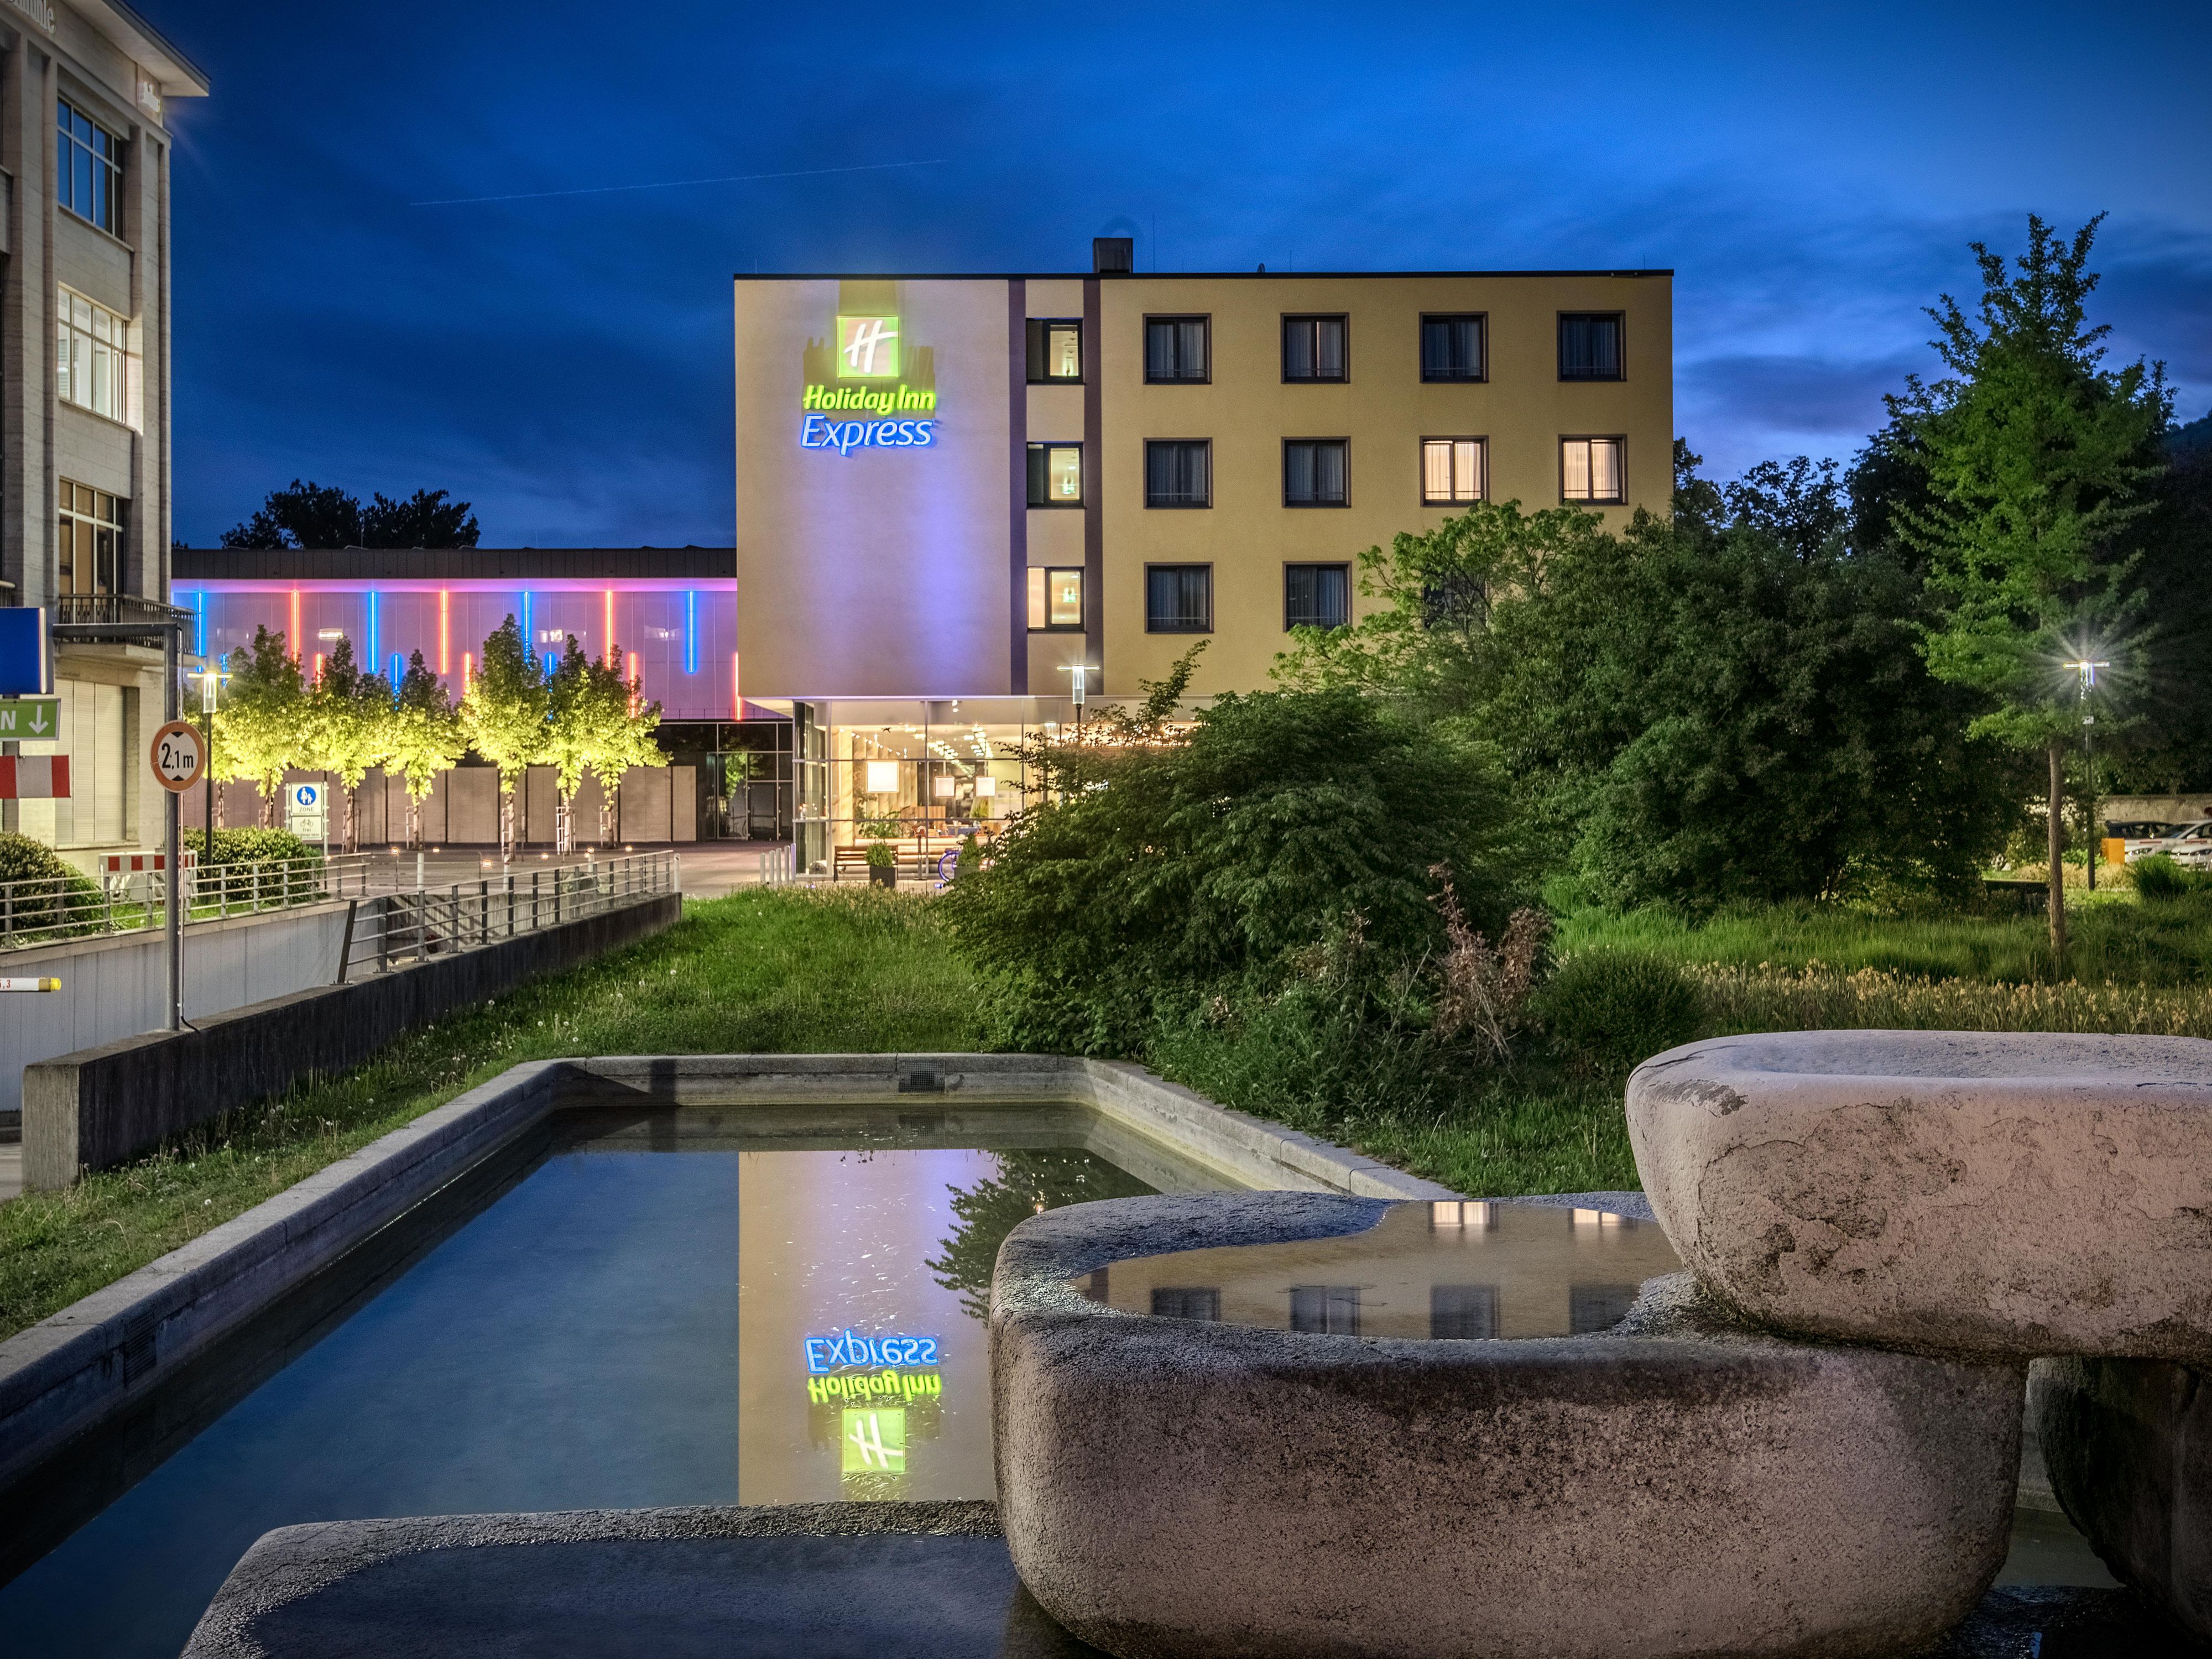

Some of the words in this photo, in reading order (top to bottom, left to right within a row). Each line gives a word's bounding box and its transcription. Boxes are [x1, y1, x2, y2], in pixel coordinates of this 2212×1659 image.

[844, 320, 898, 373] H
[804, 384, 896, 415] Holiday
[896, 384, 936, 410] Inn
[802, 414, 933, 456] Express
[161, 743, 179, 769] 2,1
[183, 755, 194, 768] m
